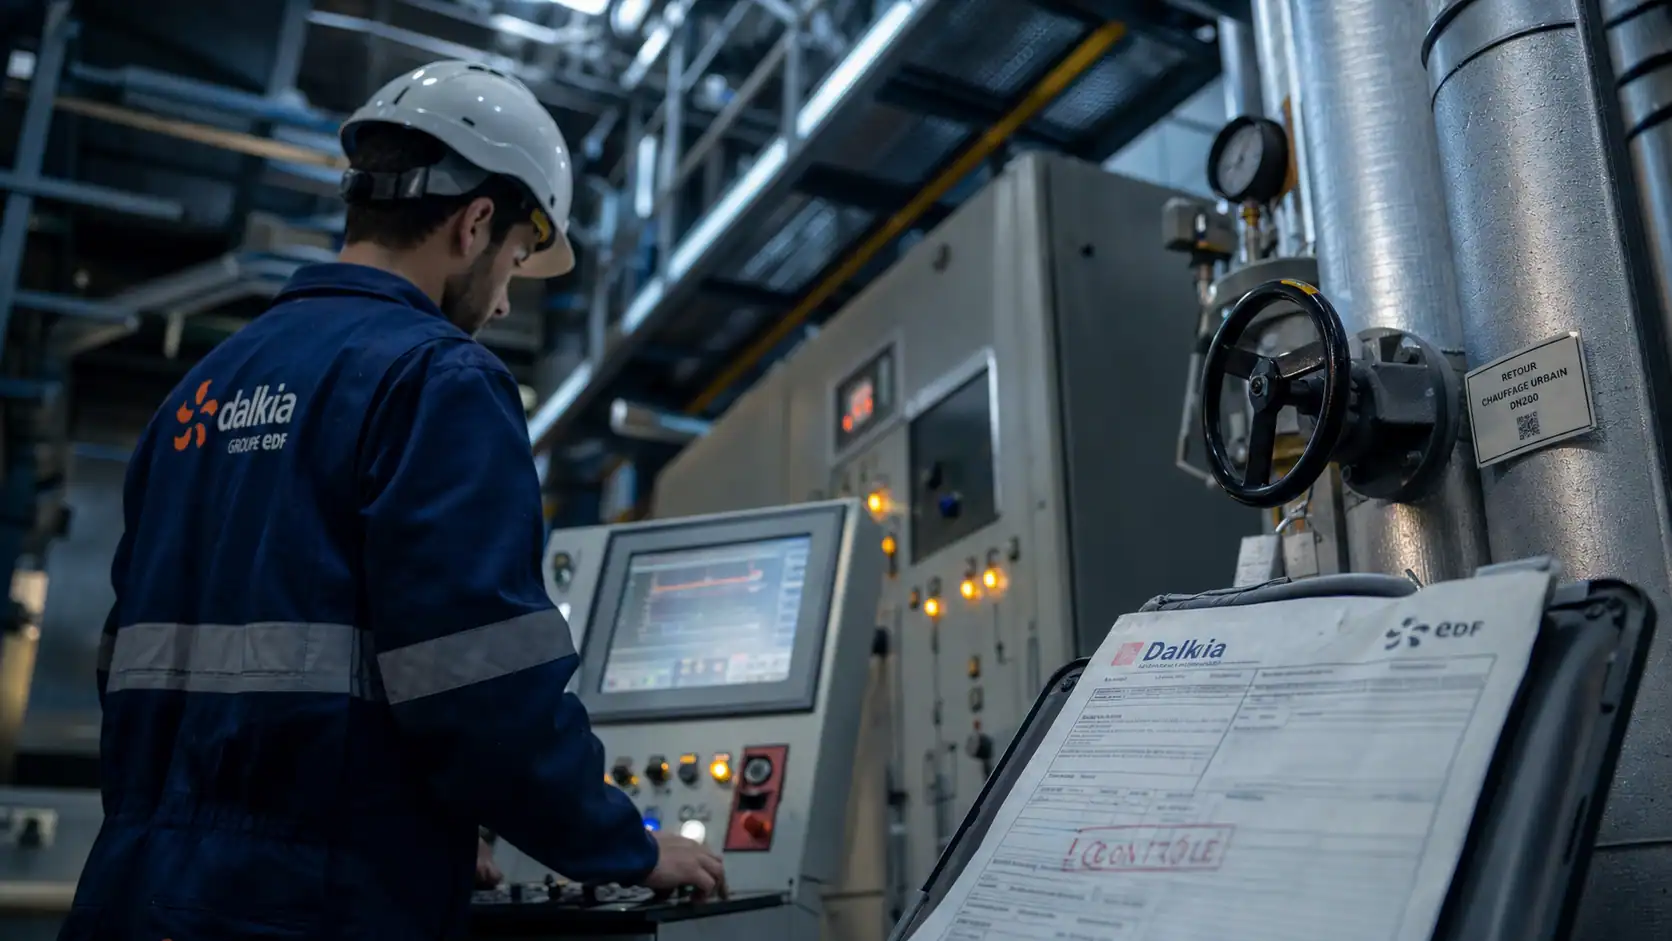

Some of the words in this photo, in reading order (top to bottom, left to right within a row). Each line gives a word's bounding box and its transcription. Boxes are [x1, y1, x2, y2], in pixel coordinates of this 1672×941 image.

[1501, 361, 1538, 382] RETOUR
[1481, 381, 1529, 407] CHAUFFAGE
[1530, 367, 1568, 388] URBAIN
[217, 383, 297, 432] dalkia
[1509, 392, 1539, 411] DN200
[227, 435, 261, 454] GROUPE
[1142, 638, 1227, 662] Dalkia
